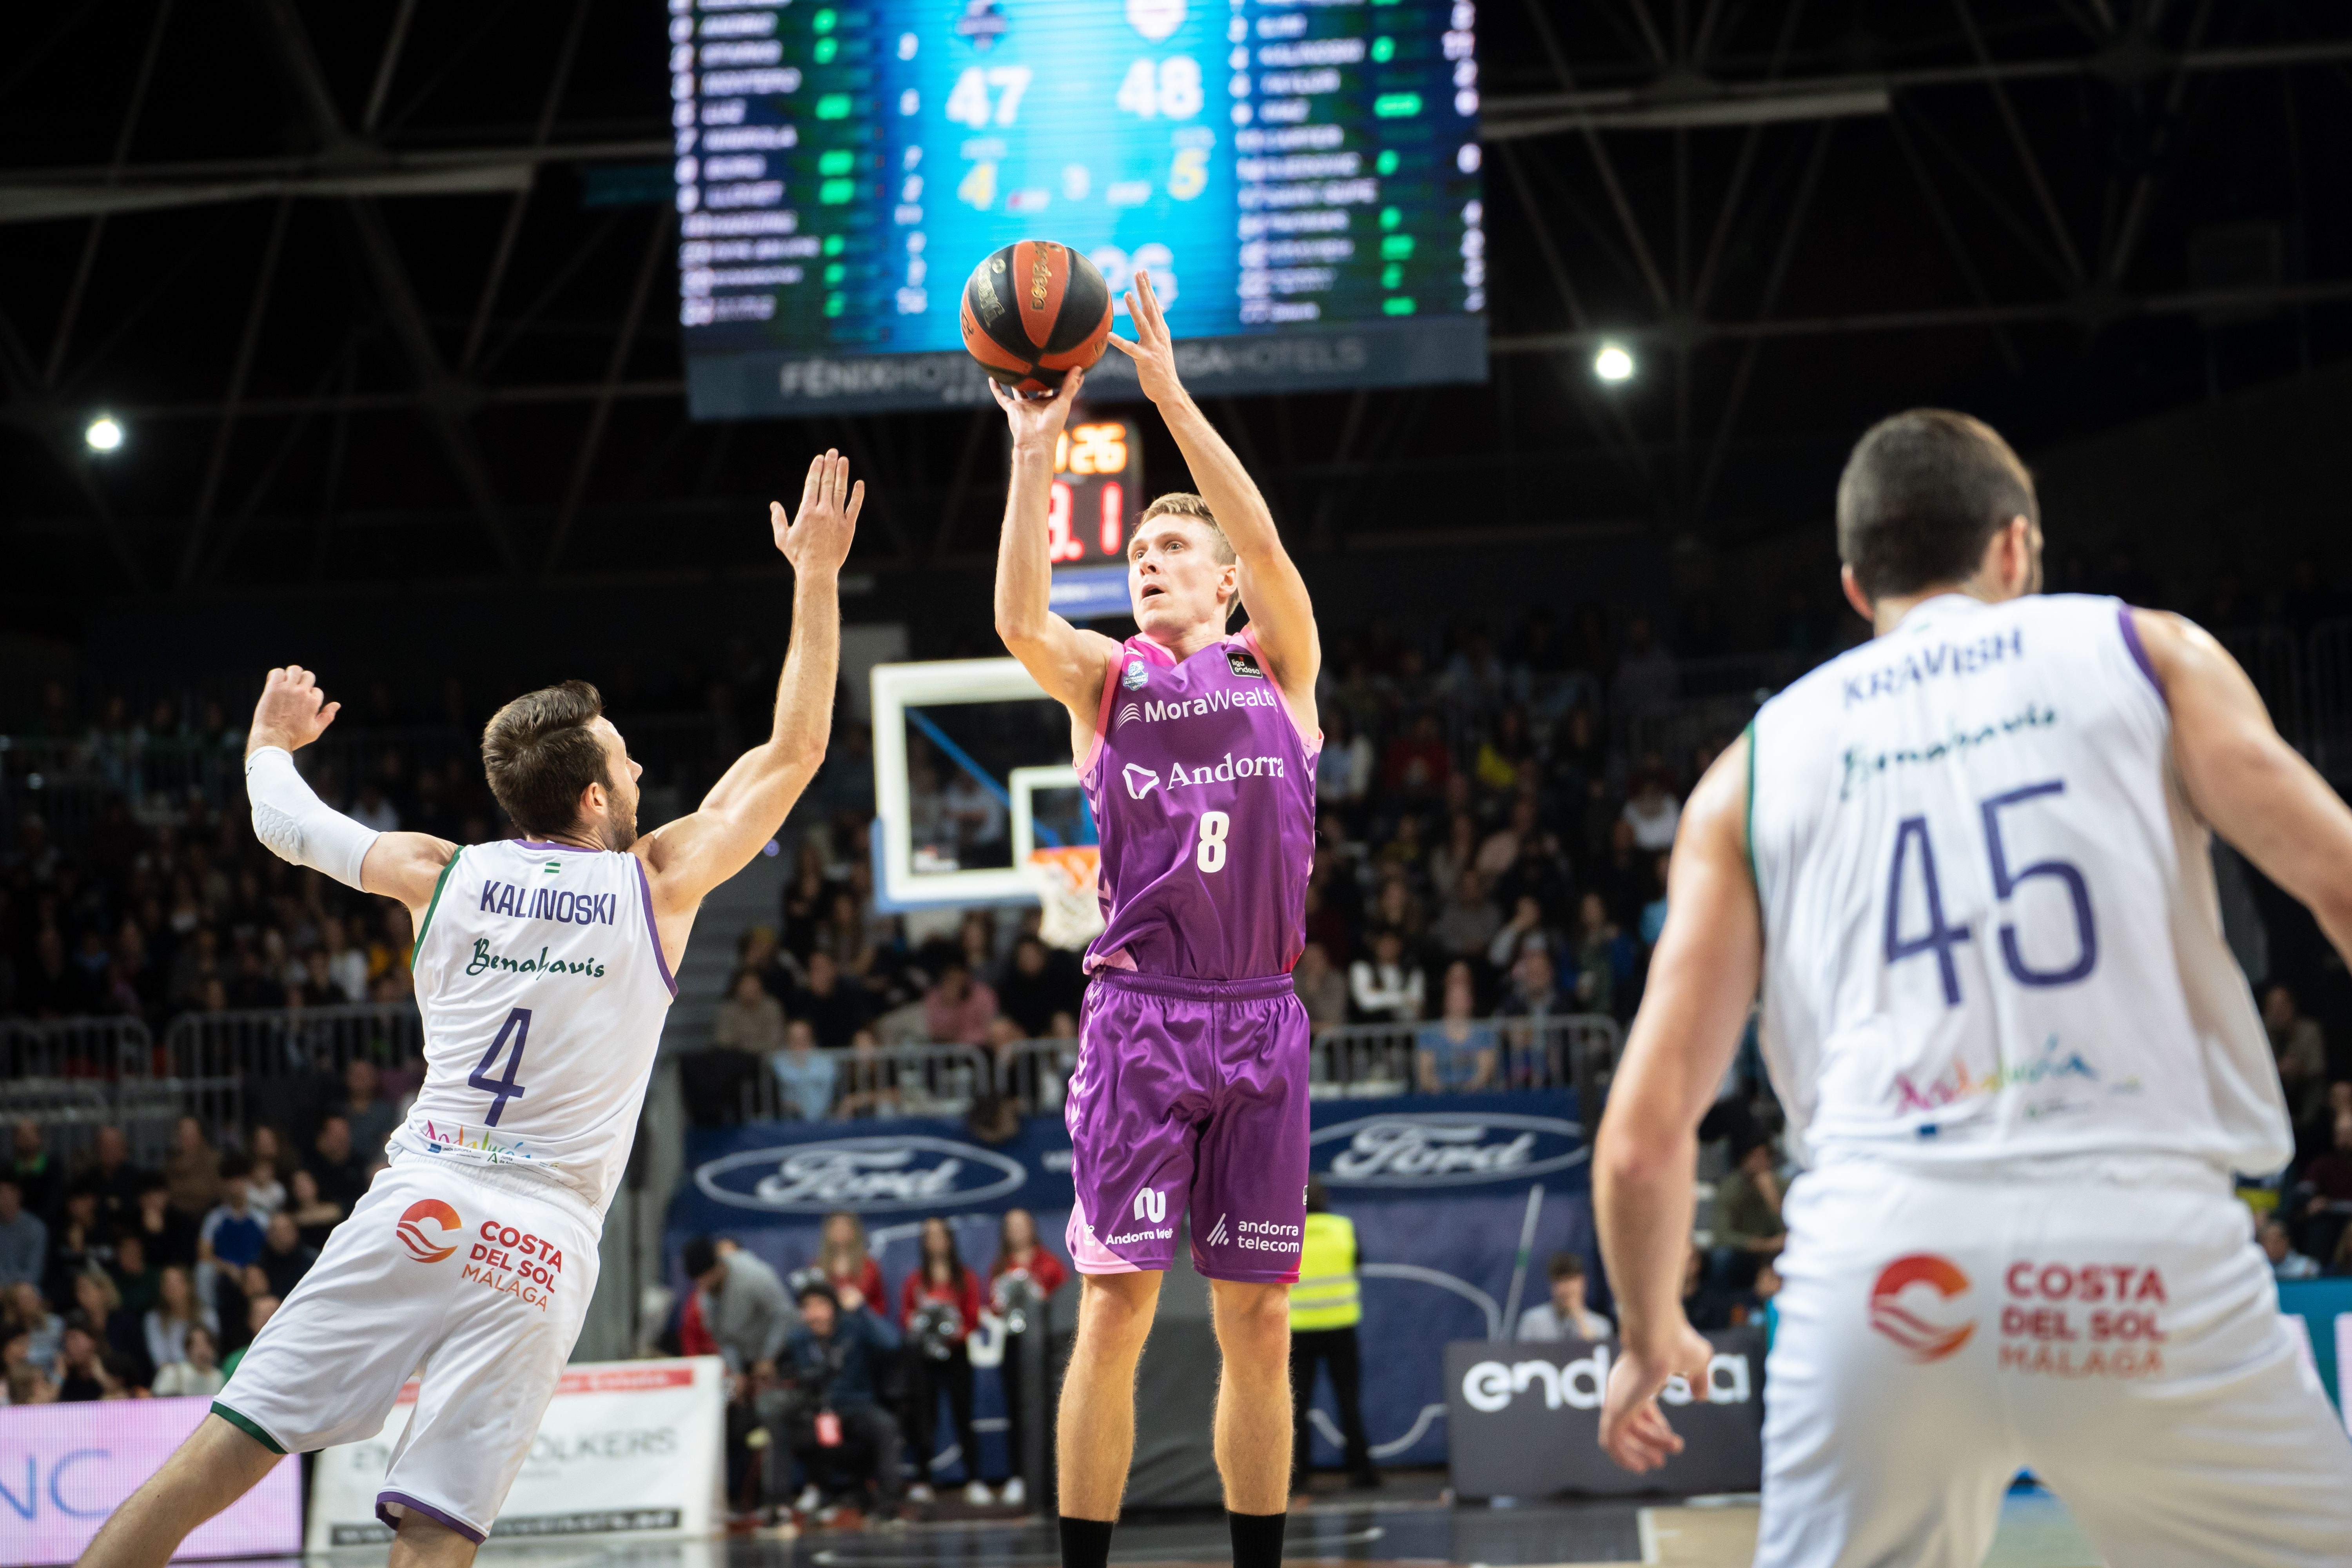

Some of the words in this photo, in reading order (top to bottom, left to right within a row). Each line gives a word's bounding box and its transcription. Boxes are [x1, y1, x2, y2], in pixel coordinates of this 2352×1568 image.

[945, 67, 1033, 127] 47
[1117, 56, 1203, 119] 48
[1234, 666, 1260, 675] endesa
[1842, 627, 2024, 708] KRAVISH
[1166, 752, 1284, 791] Andorra
[1196, 811, 1230, 873] 8
[479, 880, 617, 926] KALINOSKI
[1884, 779, 2099, 1009] 45
[467, 1007, 533, 1128] 4
[1331, 1121, 1537, 1179] Ford
[755, 1149, 963, 1204] Ford
[480, 1220, 562, 1274] COSTA
[1105, 1231, 1155, 1245] Andorra
[1237, 1235, 1299, 1252] telecom
[1238, 1220, 1299, 1236] andorra
[461, 1263, 549, 1312] MÁLAGA
[470, 1243, 512, 1272] DEL
[517, 1259, 555, 1294] SOL
[2003, 1260, 2168, 1304] COSTA
[1998, 1305, 2078, 1341] DEL
[2089, 1308, 2168, 1344] SOL
